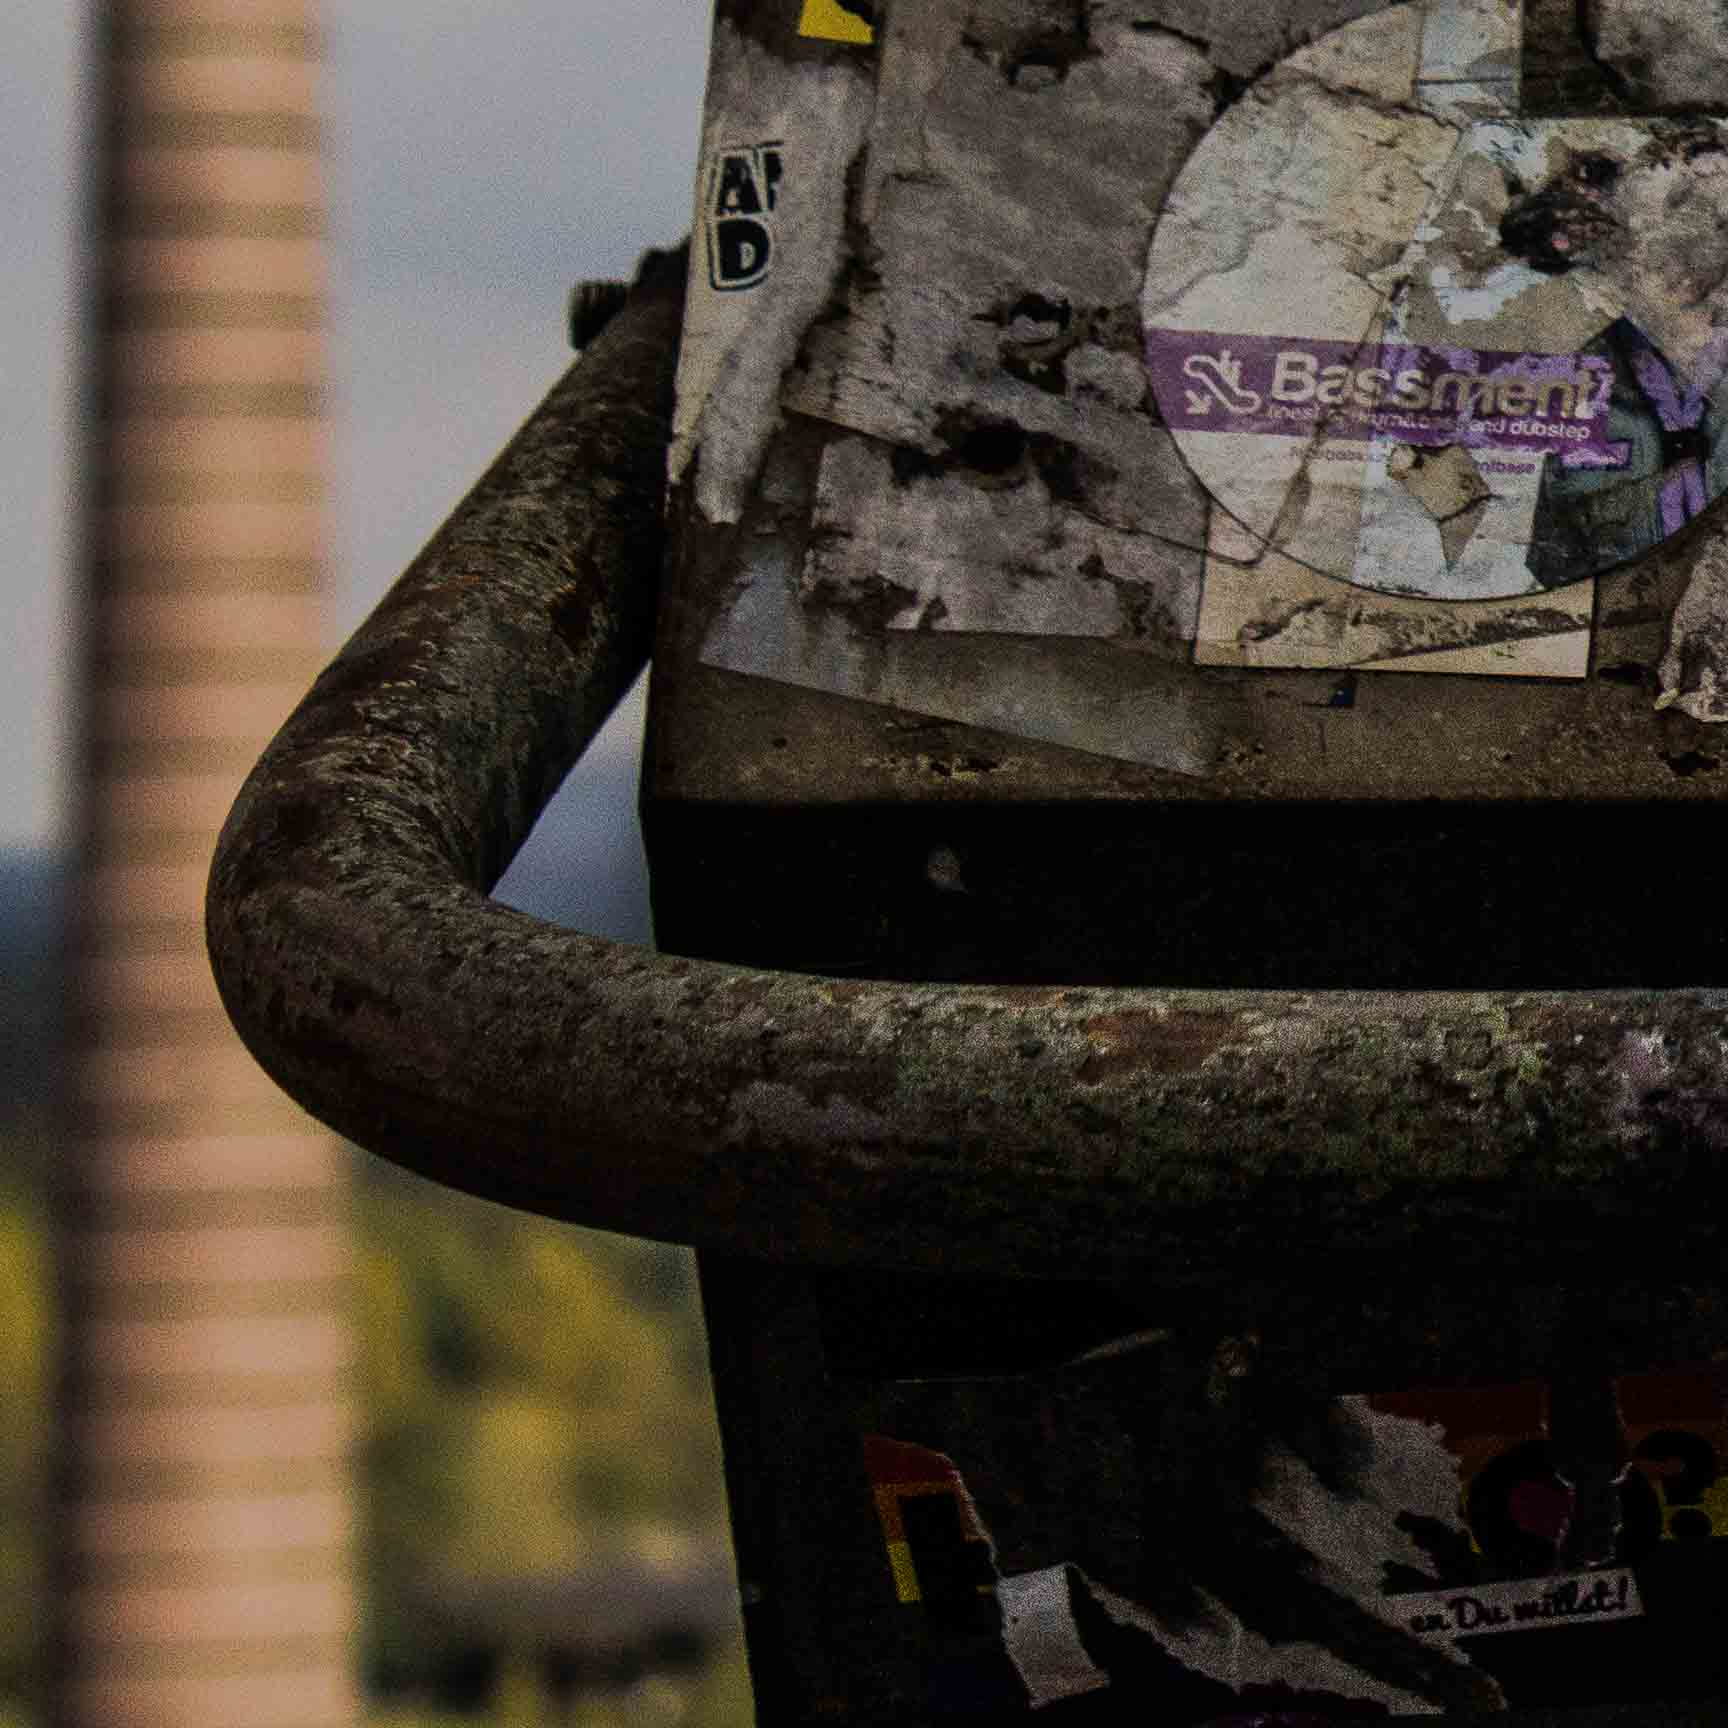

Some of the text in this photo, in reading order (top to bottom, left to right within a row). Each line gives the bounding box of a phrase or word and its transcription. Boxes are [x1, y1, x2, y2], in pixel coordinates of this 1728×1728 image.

[1271, 351, 1600, 421] Bassment
[1510, 419, 1592, 443] dubstep
[1449, 1595, 1508, 1630] Du
